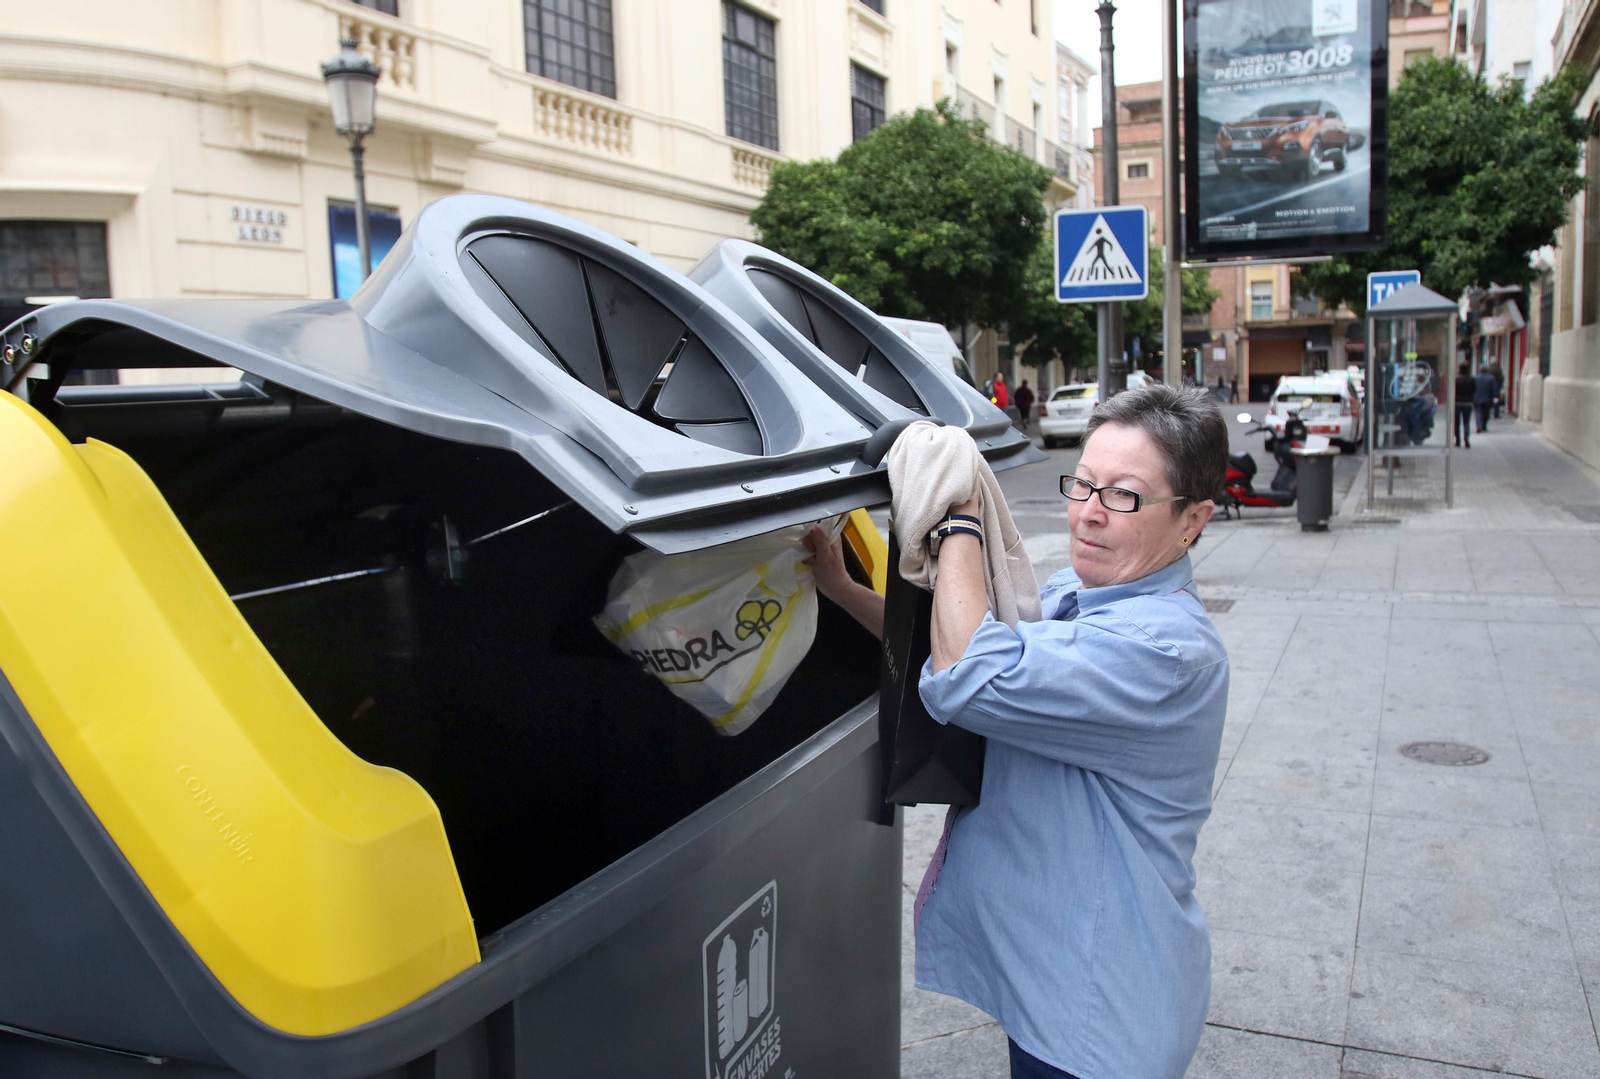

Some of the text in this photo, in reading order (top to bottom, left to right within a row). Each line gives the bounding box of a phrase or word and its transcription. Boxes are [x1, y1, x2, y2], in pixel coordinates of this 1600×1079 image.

[1214, 44, 1354, 80] PEUGEOT 3008
[231, 206, 287, 226] DIEGO
[1275, 208, 1309, 218] MOTION
[1317, 205, 1356, 216] EMOTION
[885, 638, 899, 684] RABAT
